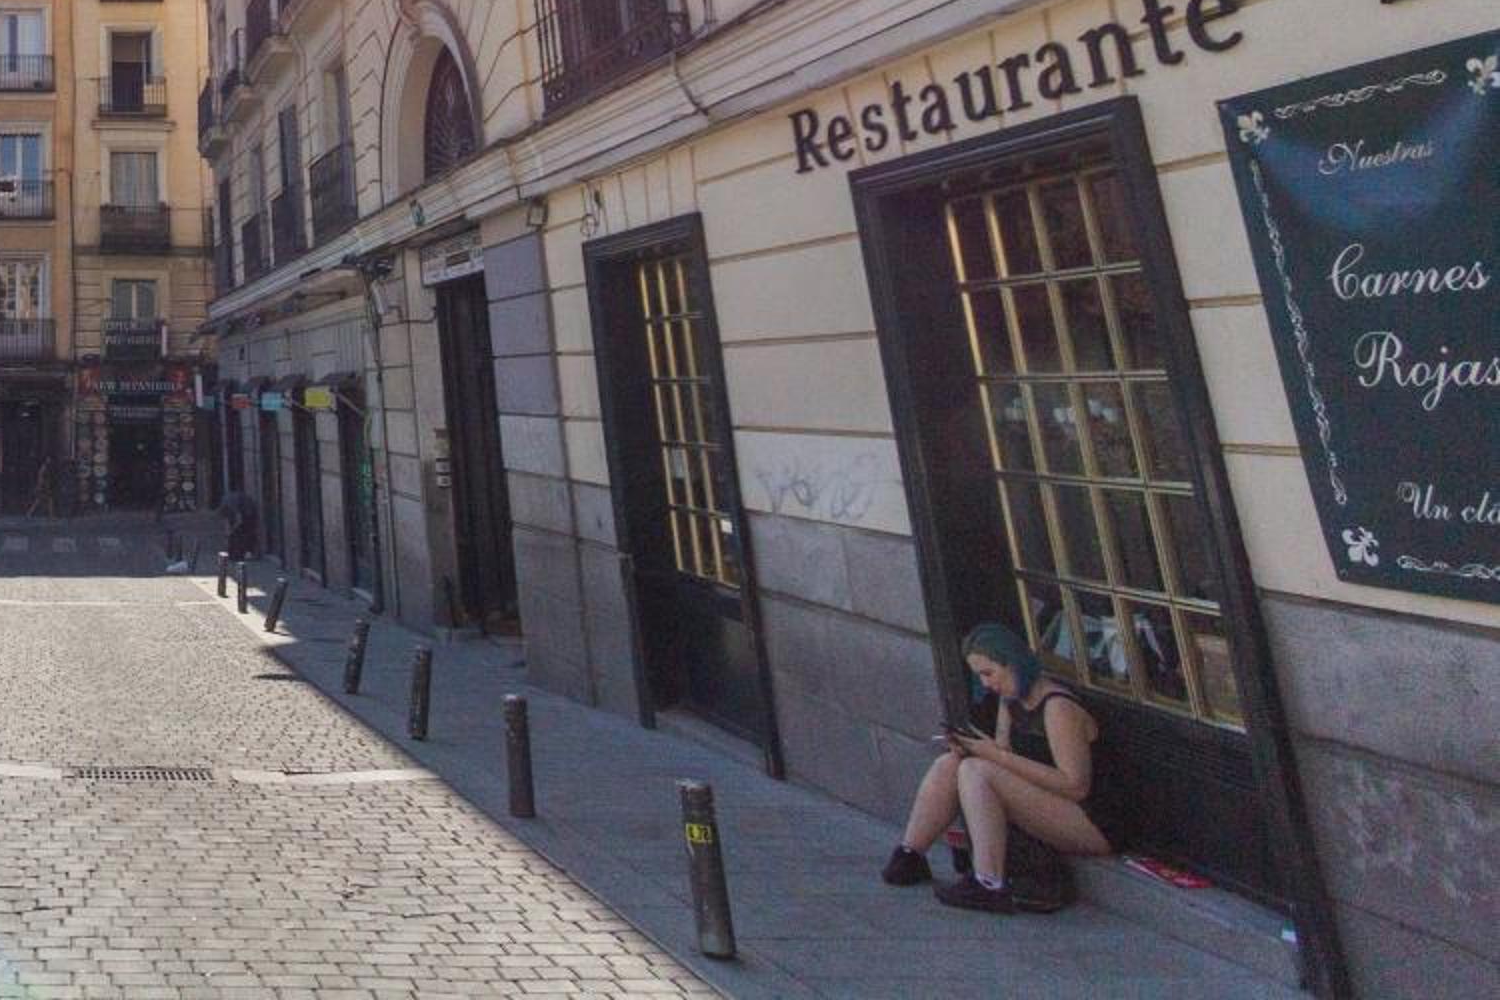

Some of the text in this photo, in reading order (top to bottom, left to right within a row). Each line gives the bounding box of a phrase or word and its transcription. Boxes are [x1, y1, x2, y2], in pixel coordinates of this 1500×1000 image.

[1318, 139, 1434, 176] Nuestras
[1328, 243, 1491, 301] Carnes
[1354, 331, 1500, 411] Rojas
[1396, 481, 1452, 520] Un
